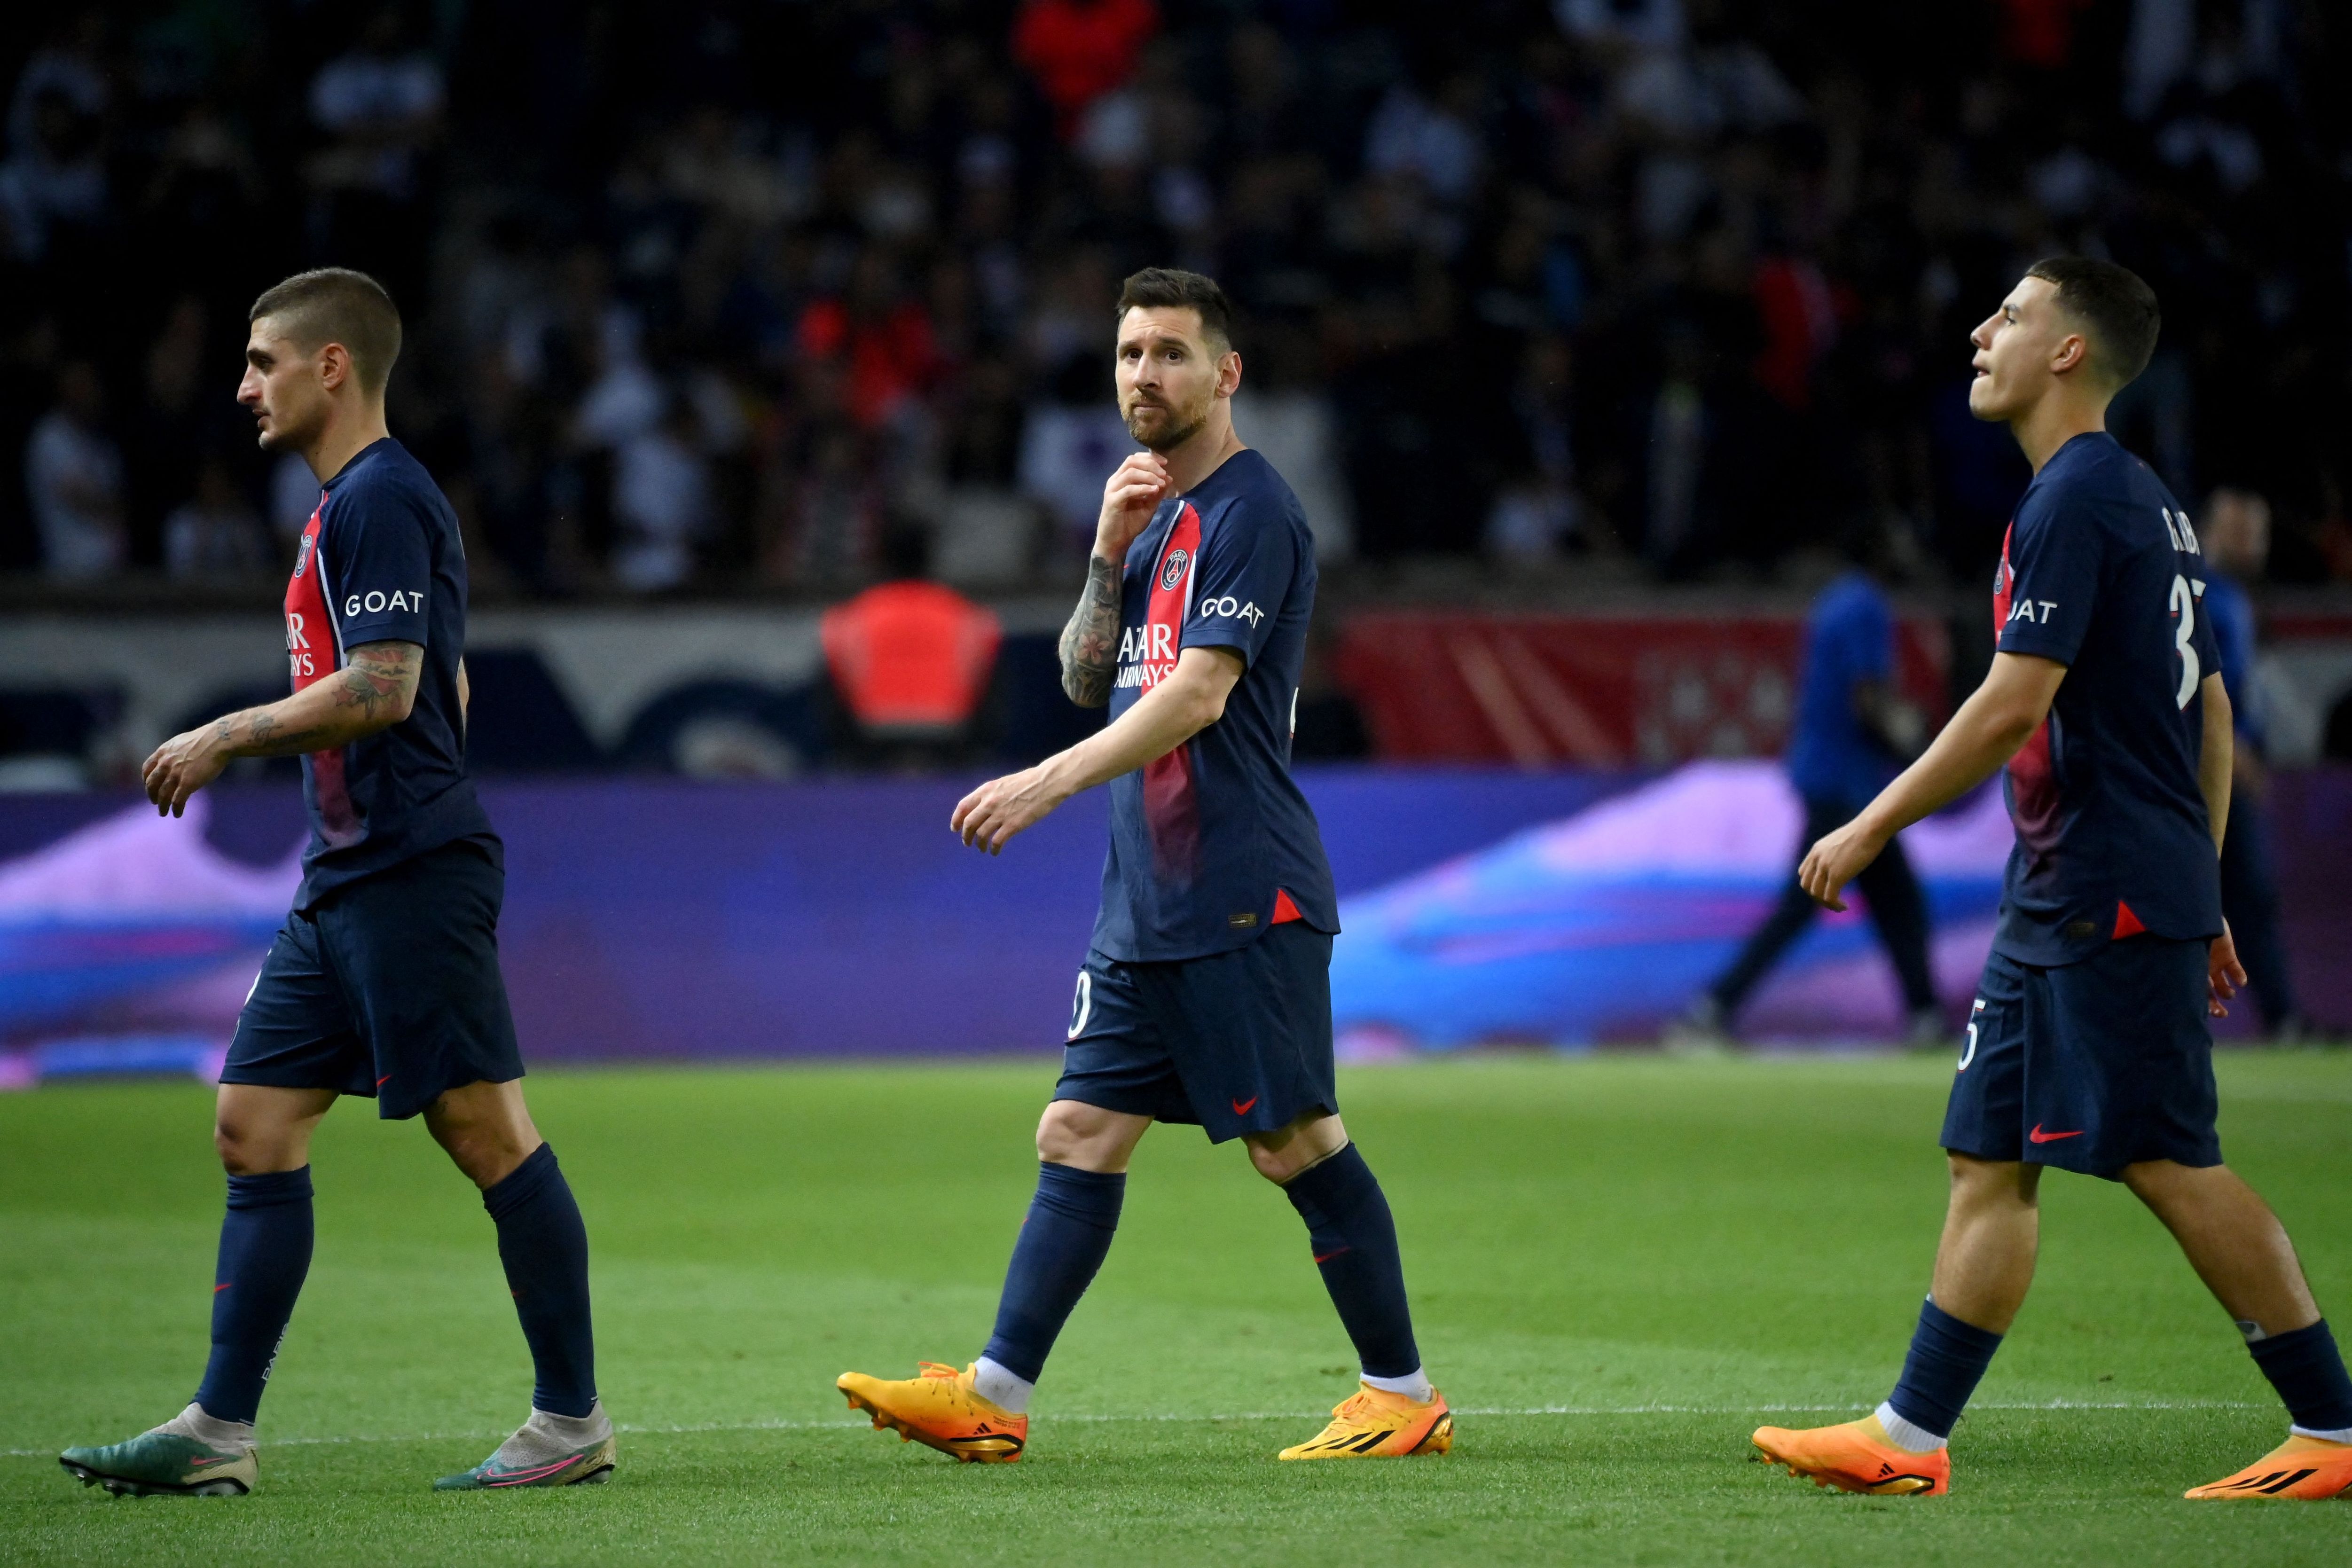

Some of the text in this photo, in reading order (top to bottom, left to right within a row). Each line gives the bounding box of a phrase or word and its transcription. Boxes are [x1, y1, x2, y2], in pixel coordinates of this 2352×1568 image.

[1169, 551, 1186, 562] PARIS
[345, 590, 424, 617] GOAT
[1201, 596, 1264, 629] GOAT
